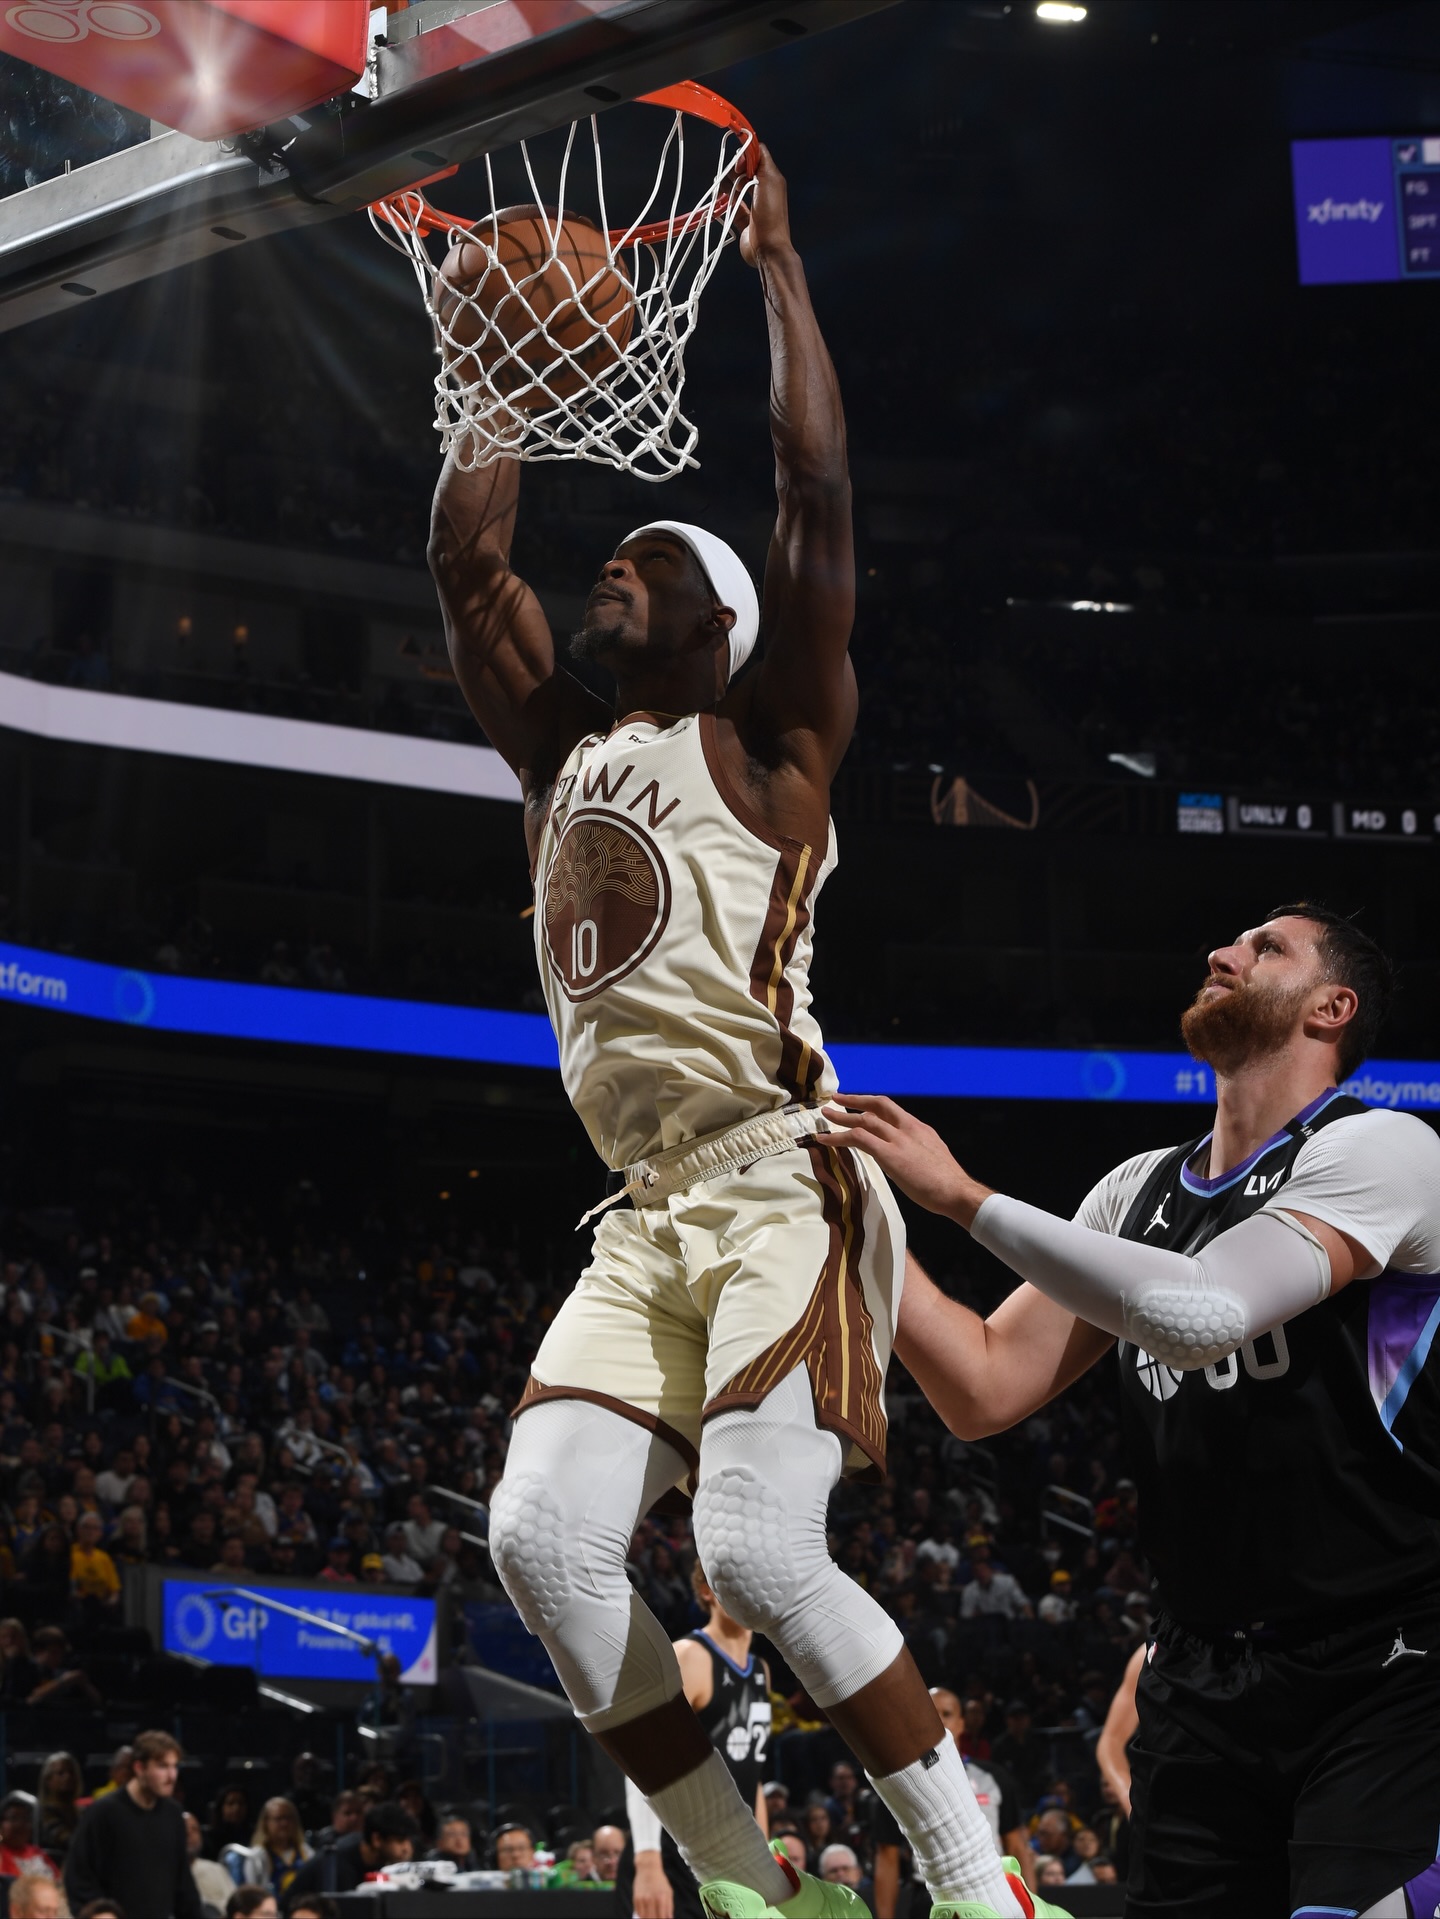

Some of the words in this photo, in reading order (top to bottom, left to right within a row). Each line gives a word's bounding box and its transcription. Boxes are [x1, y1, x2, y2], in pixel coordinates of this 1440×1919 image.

[1307, 198, 1384, 225] xfinity
[1240, 804, 1287, 825] UNLV
[572, 919, 597, 980] 10
[1175, 1071, 1207, 1095] #1
